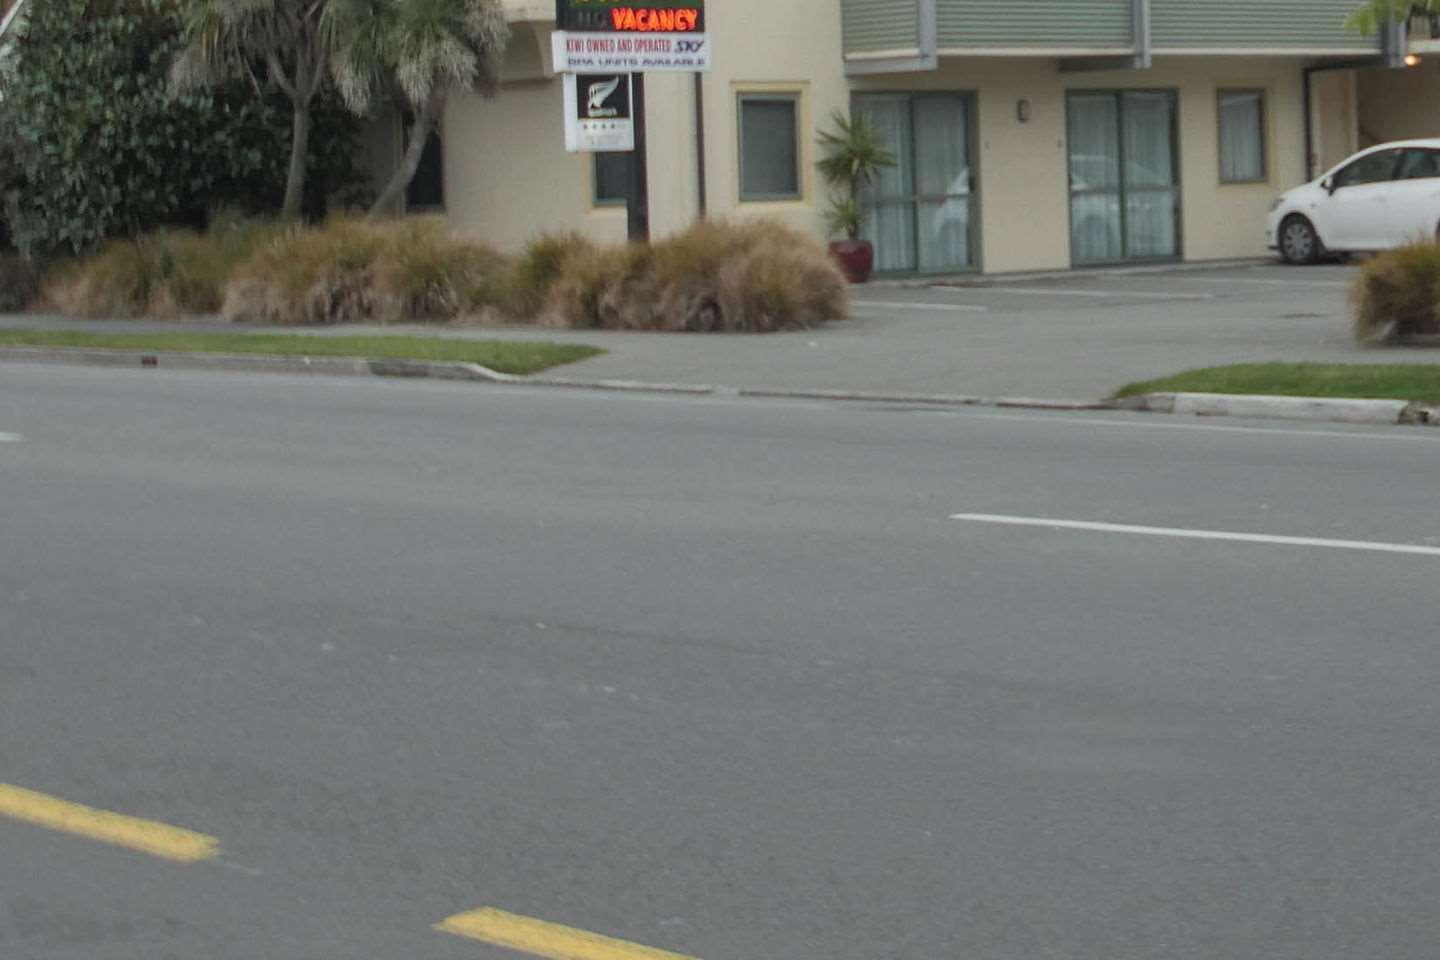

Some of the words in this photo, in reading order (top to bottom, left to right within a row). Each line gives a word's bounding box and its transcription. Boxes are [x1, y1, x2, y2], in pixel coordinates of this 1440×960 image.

[611, 7, 698, 31] VACANCY
[566, 40, 584, 53] KIWI
[586, 40, 616, 53] OWNED
[617, 40, 632, 53] AND
[634, 39, 672, 53] OPERATED
[642, 56, 705, 66] AVAILABLE
